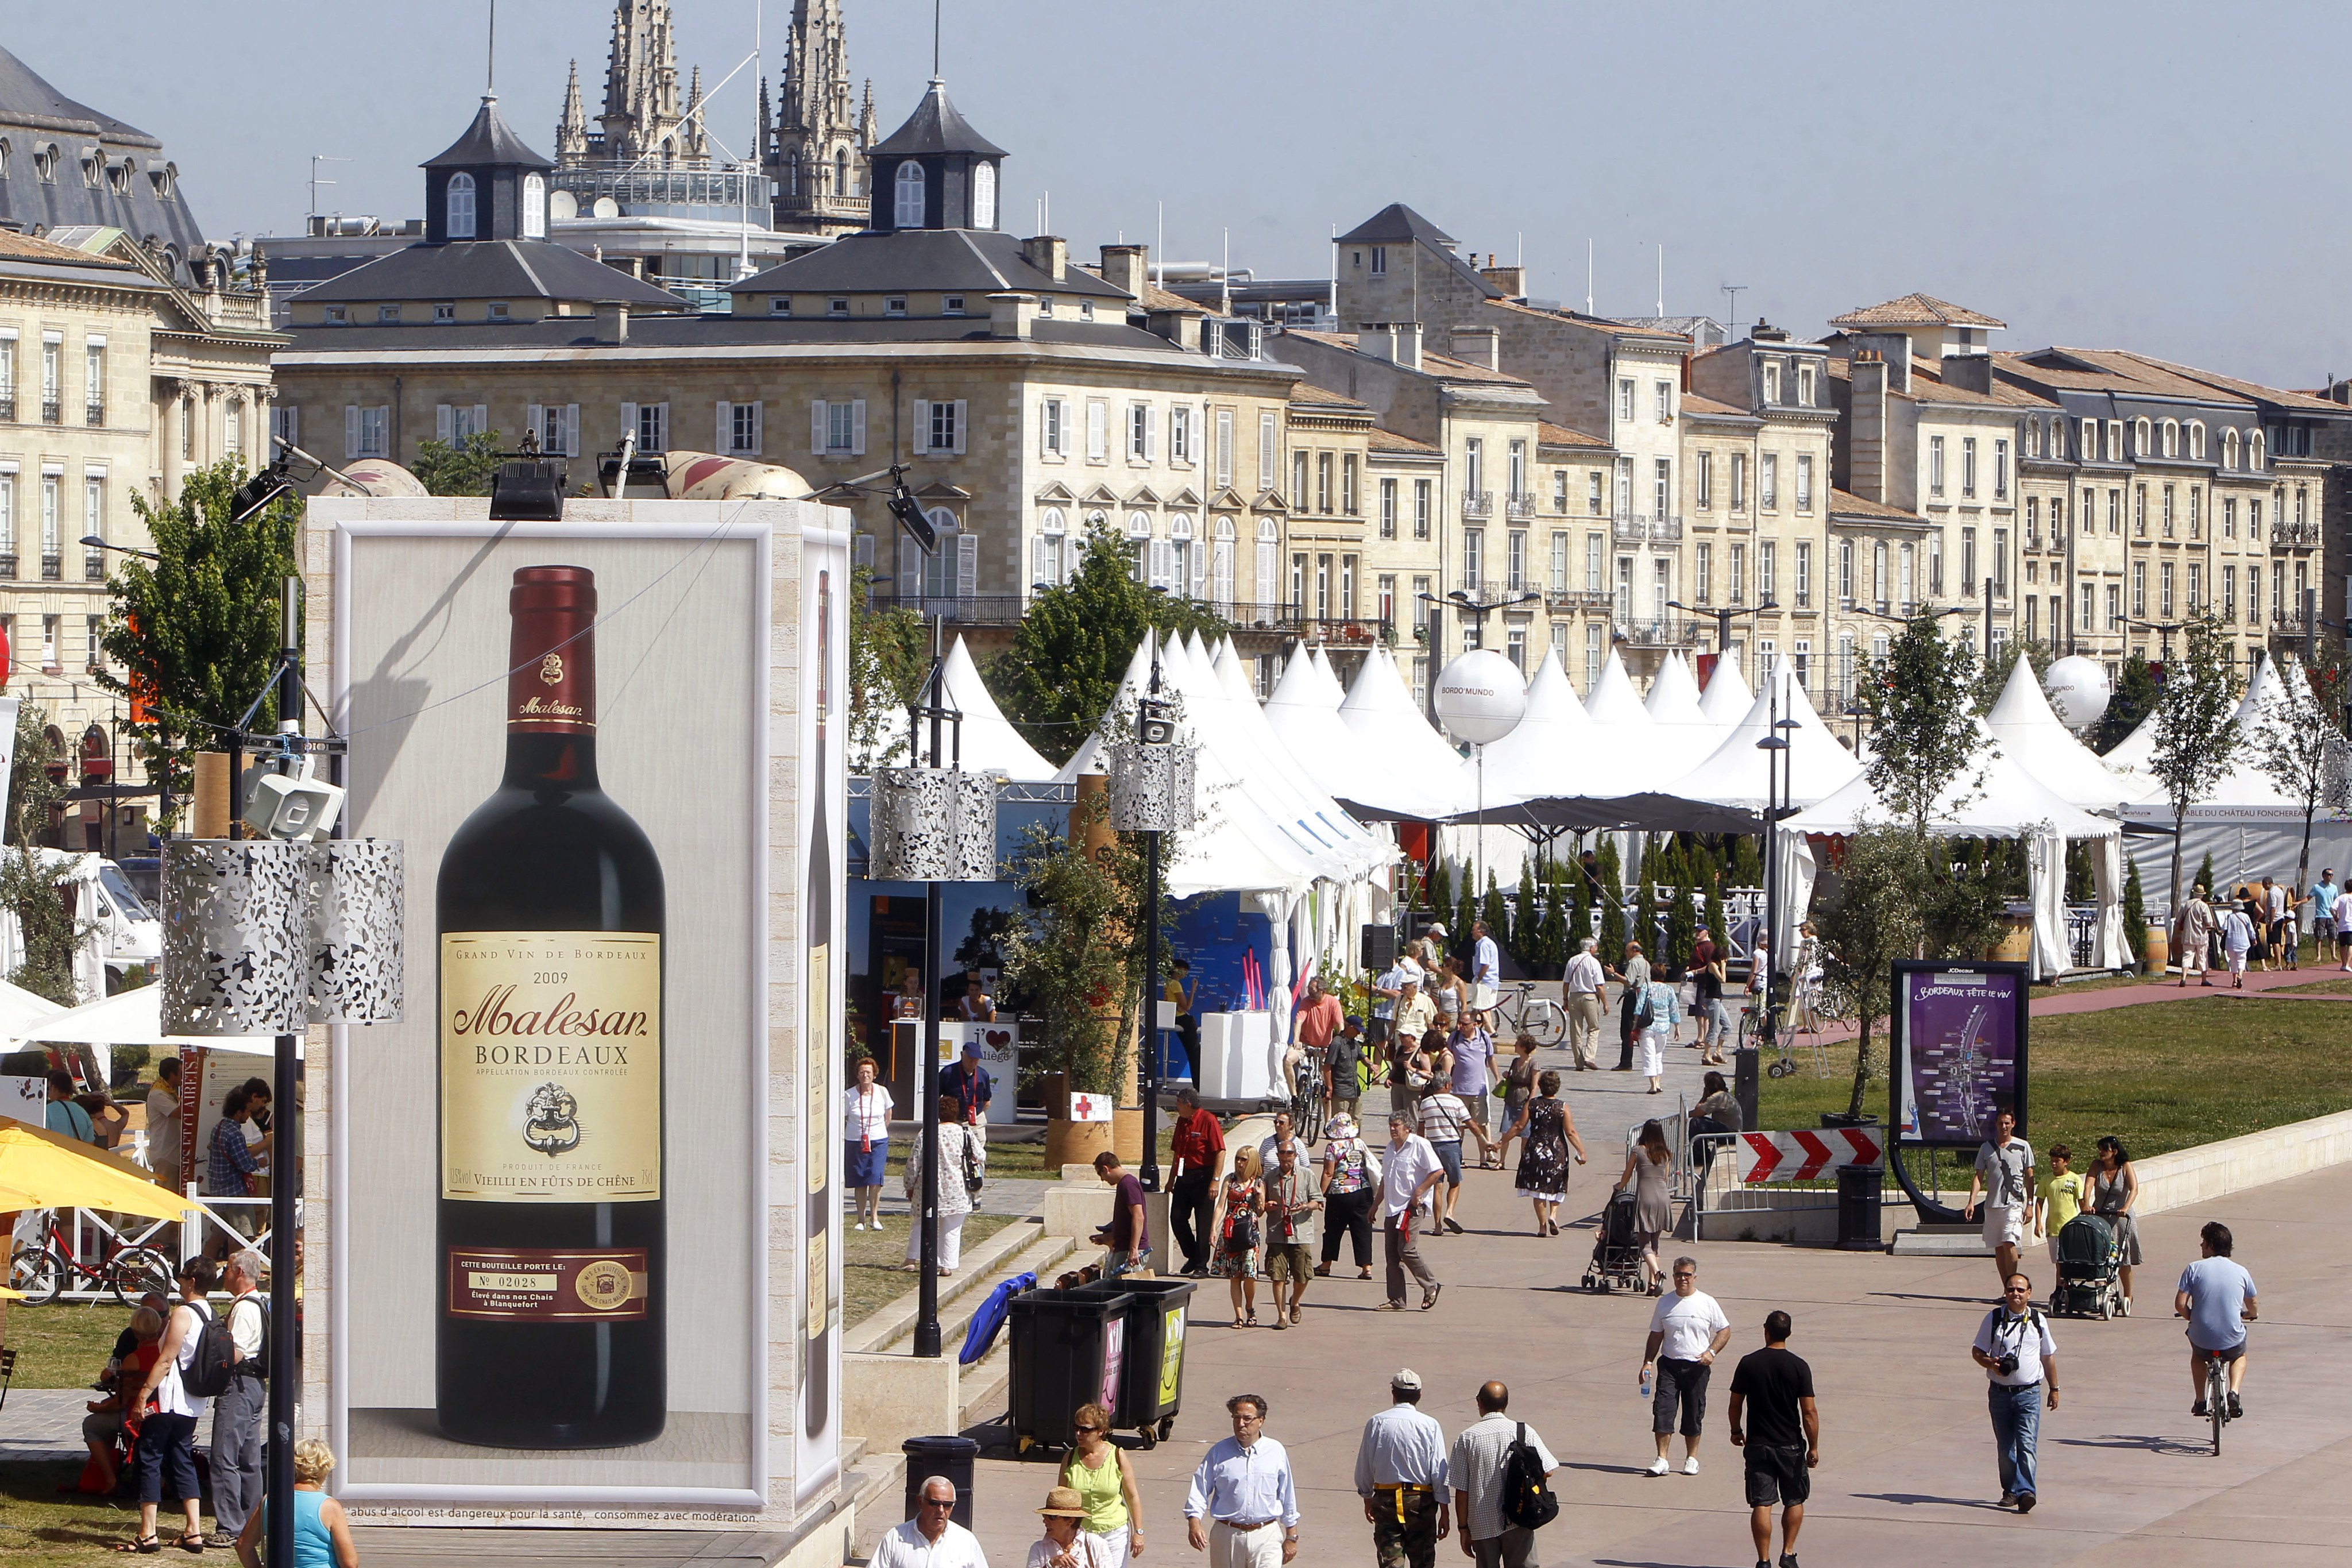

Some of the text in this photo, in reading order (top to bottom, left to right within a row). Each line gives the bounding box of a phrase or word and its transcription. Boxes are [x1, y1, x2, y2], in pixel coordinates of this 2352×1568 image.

[1442, 687, 1494, 696] BORDO'MUNDO
[519, 697, 582, 716] Malesan
[2219, 808, 2255, 817] CHÂTEAU
[456, 949, 647, 960] GRAND VIN DE BORDEAUX
[533, 972, 569, 984] 2009
[1914, 986, 1964, 1001] BORDEAUX
[1966, 987, 1987, 997] FÊTE
[453, 984, 648, 1036] Malesan
[476, 1046, 629, 1065] BORDEAUX
[474, 1174, 635, 1187] VIEILLI EN FÛTS DE CHÊNE
[461, 1261, 480, 1269] CETTE
[481, 1261, 522, 1270] BOUTEILLE
[524, 1263, 550, 1271] PORTE
[584, 1271, 593, 1281] MIS
[603, 1266, 626, 1281] BOUTEILLE
[499, 1276, 537, 1288] 02028
[472, 1290, 491, 1299] Élevé
[492, 1292, 510, 1300] dans
[530, 1293, 553, 1301] Chais
[589, 1295, 598, 1303] NOS
[613, 1285, 627, 1301] MALESAN
[484, 1299, 538, 1308] à Blanquefort
[347, 1506, 759, 1523] 'abus d'alcool est dangereux pour la santé, consommez avec modération.
